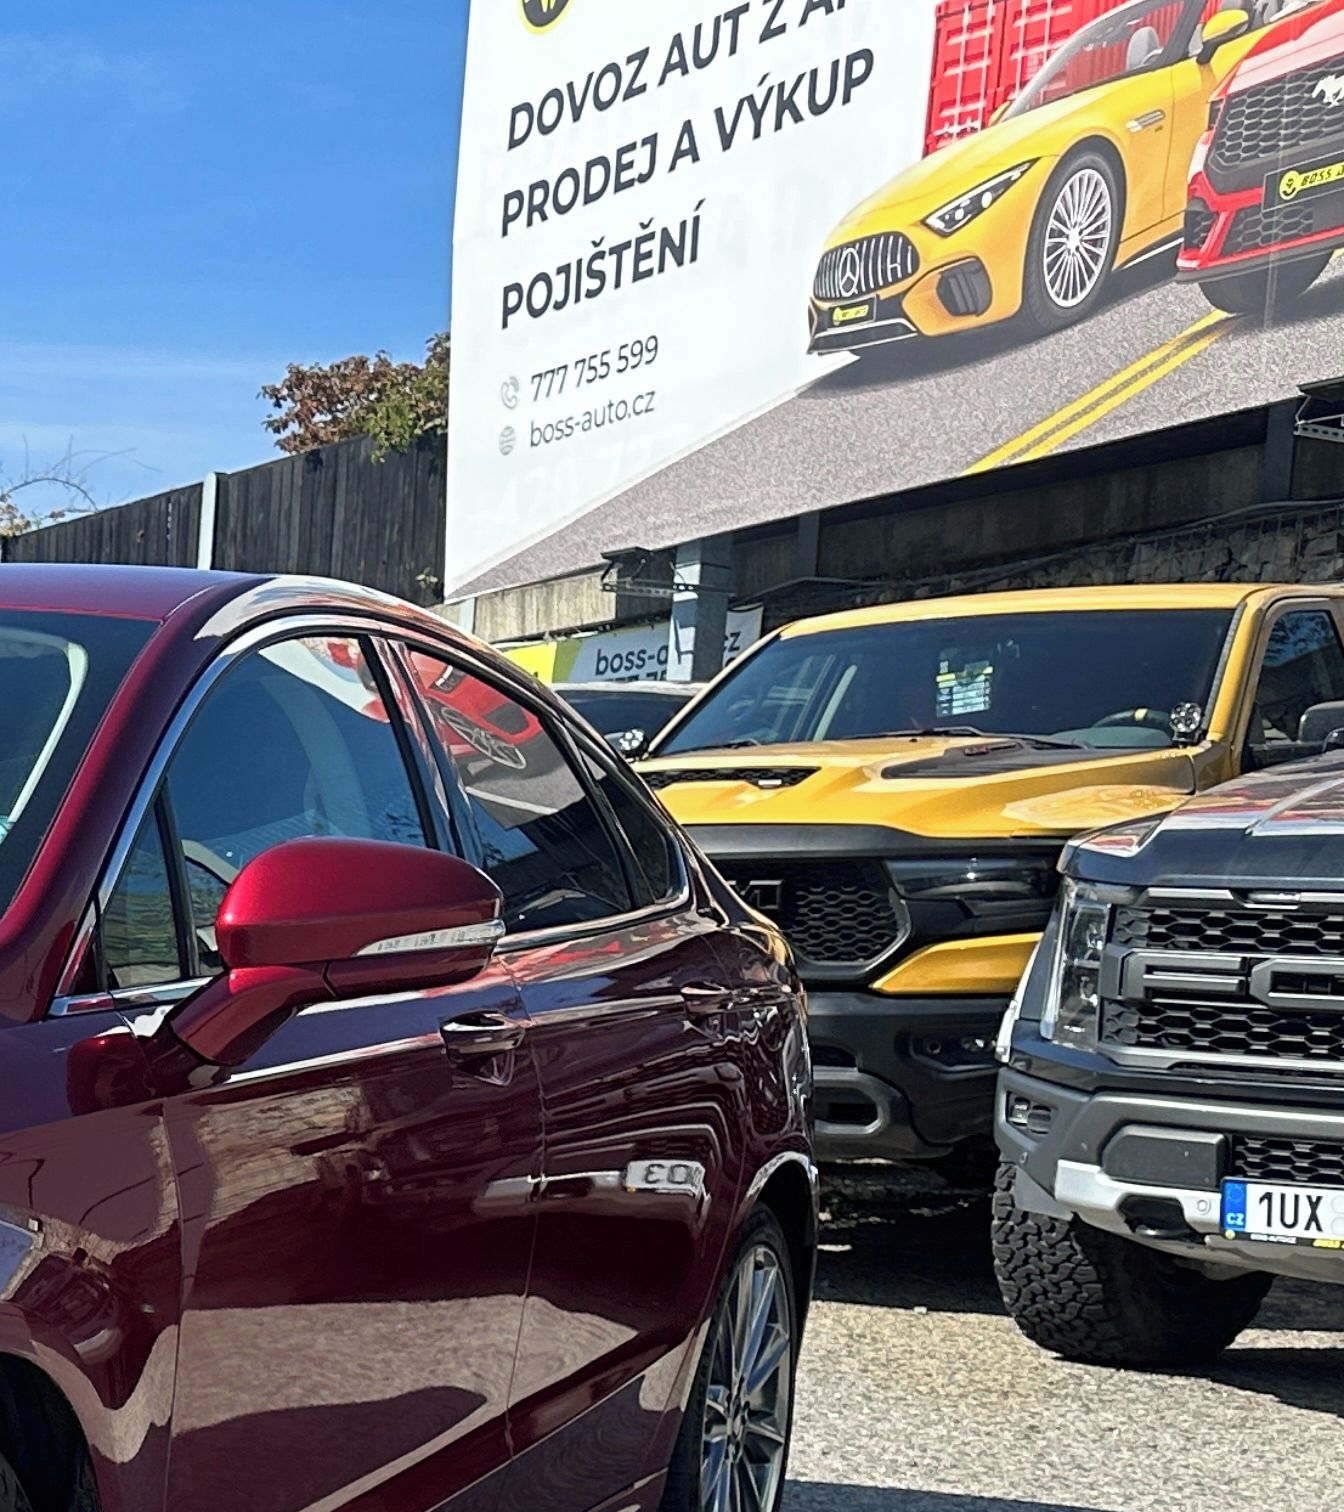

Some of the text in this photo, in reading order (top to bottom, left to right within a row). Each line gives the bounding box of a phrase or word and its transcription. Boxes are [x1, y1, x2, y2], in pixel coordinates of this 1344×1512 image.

[507, 46, 650, 151] DOVOZ
[657, 2, 750, 88] AUT
[759, 0, 788, 44] Z
[501, 48, 874, 238] PRODEJ A VÝKUP
[501, 198, 706, 330] POJIŠTĚNÍ
[530, 334, 659, 402] 777 755 599
[529, 391, 656, 449] boss-auto.cz
[1226, 1212, 1245, 1226] CZ
[1258, 1191, 1324, 1233] 1UX
